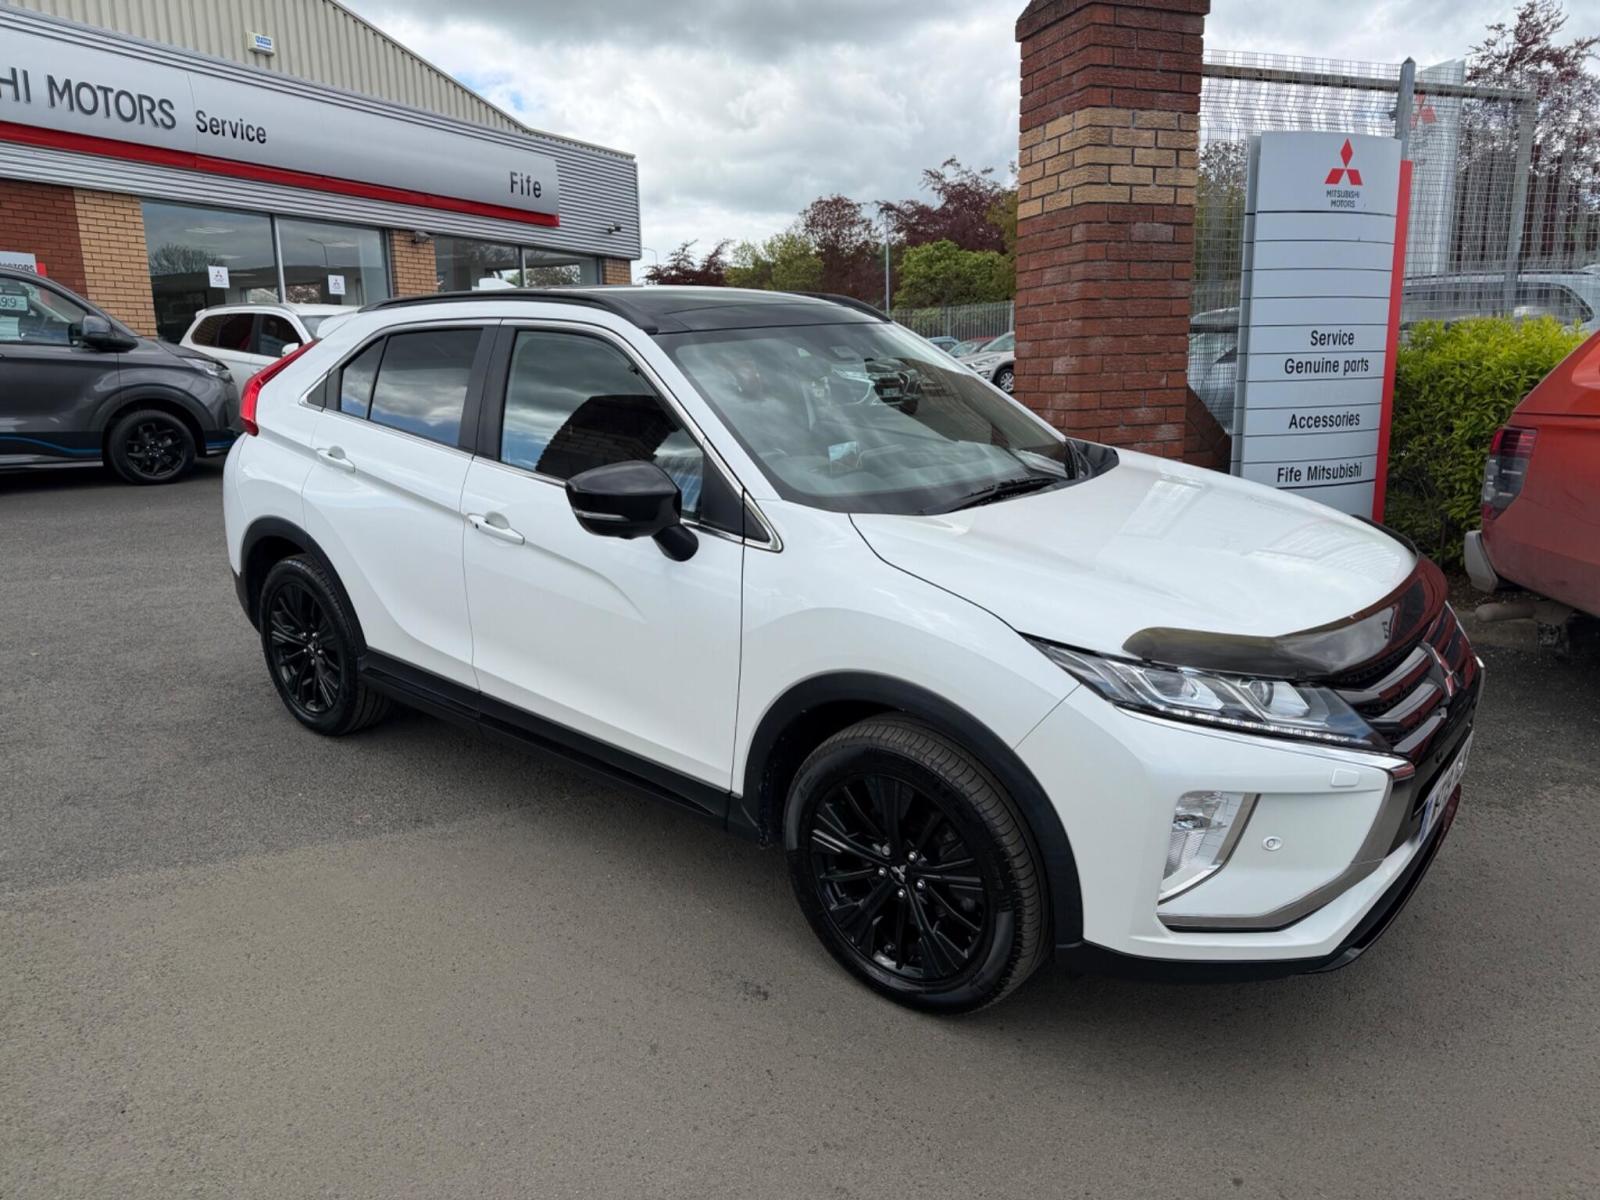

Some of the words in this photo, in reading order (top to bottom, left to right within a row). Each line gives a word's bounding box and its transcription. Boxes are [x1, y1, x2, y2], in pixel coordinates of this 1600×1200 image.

[46, 74, 177, 131] MOTORS
[195, 109, 267, 144] Service
[510, 171, 542, 198] Fife
[1326, 189, 1360, 199] MITSUBISHI
[1330, 199, 1356, 208] MOTORS
[1310, 329, 1355, 346] Service
[1284, 357, 1340, 374] Genuine
[1343, 357, 1369, 376] parts
[1288, 411, 1361, 429] Accessories
[1277, 466, 1302, 483] Fife
[1307, 462, 1362, 481] Mitsubishi
